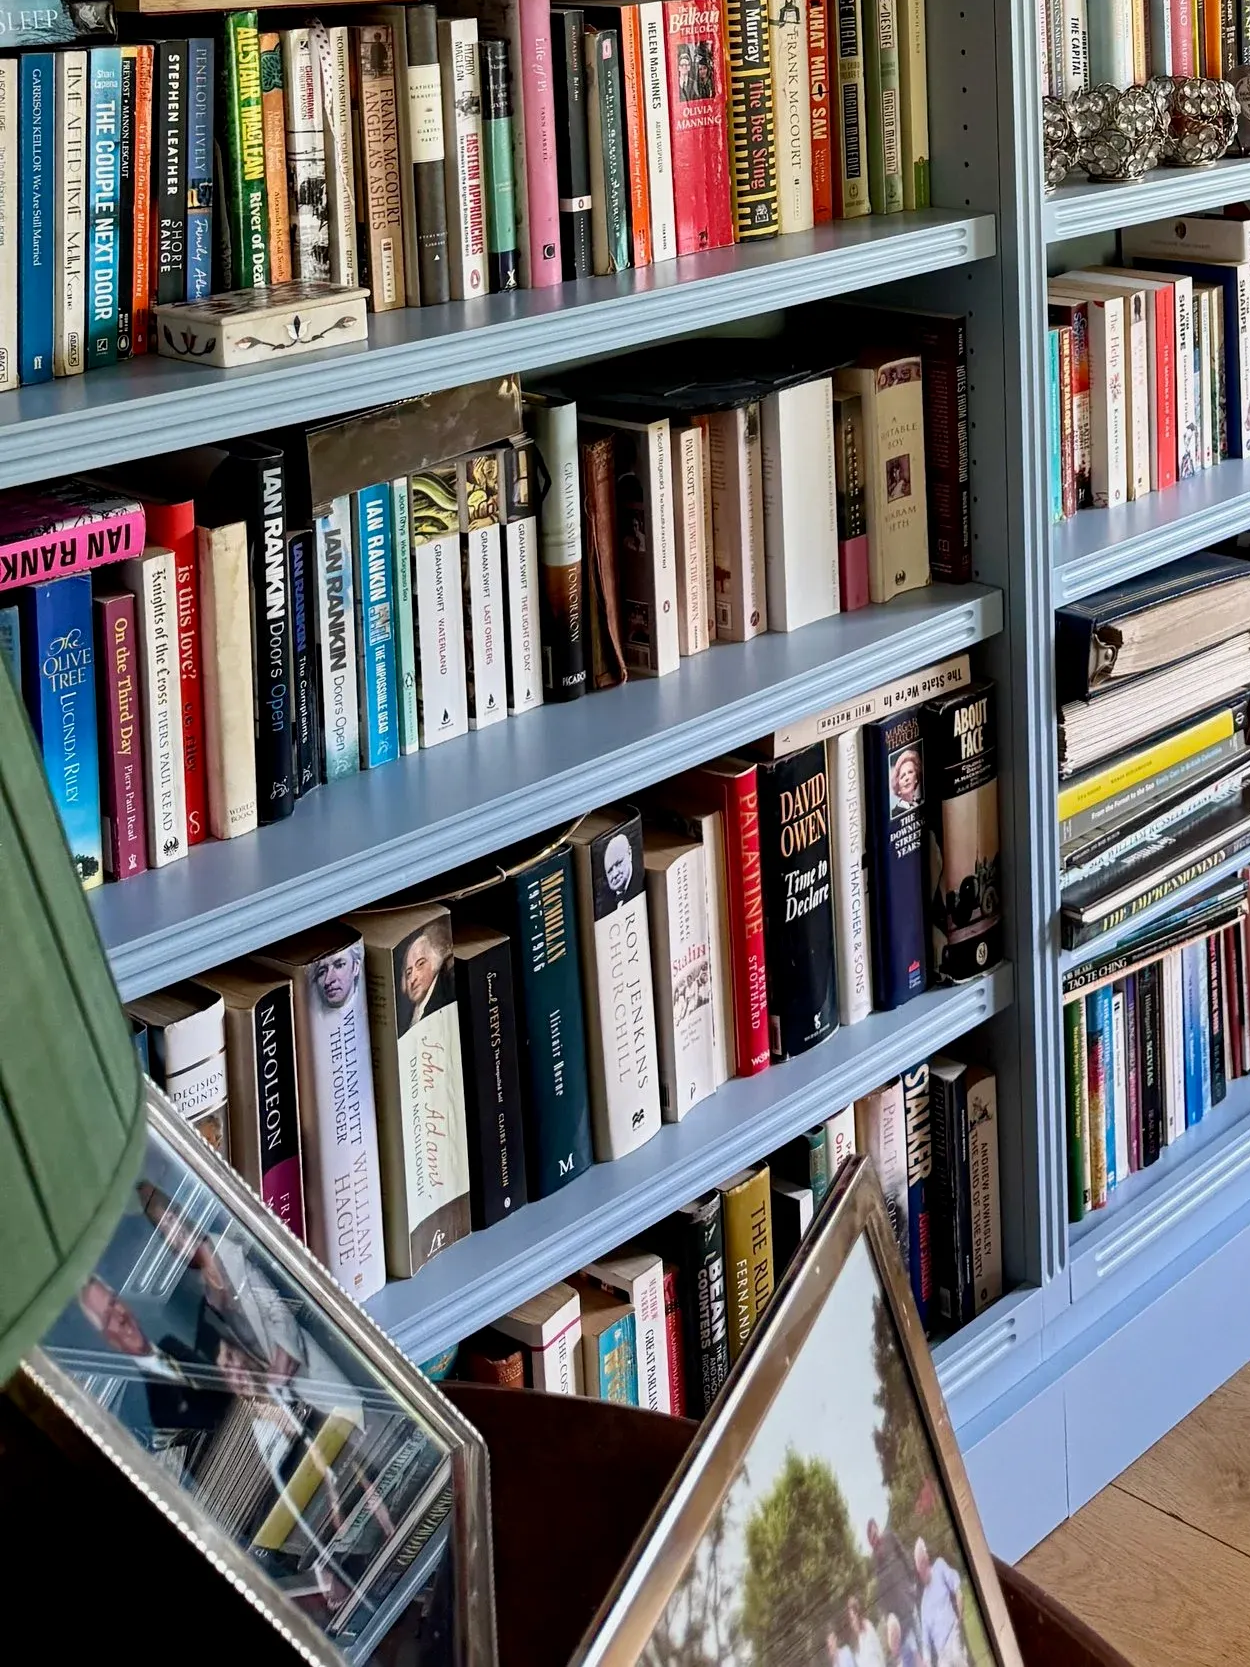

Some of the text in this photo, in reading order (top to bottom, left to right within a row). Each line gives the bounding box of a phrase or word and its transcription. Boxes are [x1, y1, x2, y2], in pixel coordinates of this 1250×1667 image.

[534, 38, 547, 92] Life of Pi
[647, 22, 661, 109] HELEN MacINNES
[745, 9, 762, 63] Murray
[1072, 37, 1080, 76] CAPITAL
[167, 54, 180, 194] STEPHEN LEATHER
[236, 27, 264, 180] ALISTAIR MACLEAN
[749, 80, 764, 110] The
[751, 114, 765, 141] Bee
[32, 69, 43, 266] GARRISON KEILLOR We Are Still Married
[94, 101, 115, 320] THE COUPLE NEXT DOOR
[365, 91, 385, 230] ANGELA'S ASHES
[381, 89, 400, 226] FRANK McCOURT
[466, 133, 484, 256] EASTERN APPROACHES
[750, 145, 768, 189] Sting
[161, 219, 172, 272] RANGE
[172, 221, 182, 270] SHORT
[1109, 312, 1121, 367] The Help
[1179, 294, 1187, 350] SHARPE
[88, 523, 131, 560] IAN
[263, 469, 287, 732] IAN RANKIN Doors Open
[434, 544, 448, 674] GRAHAM SWIFT WATERLAND
[116, 618, 134, 755] On the Third Day
[60, 693, 80, 803] LUCINDA RILEY
[779, 773, 825, 823] DAVID
[740, 790, 762, 939] PALATINE
[781, 804, 827, 857] OWEN
[542, 869, 566, 963] MACMILLAN
[608, 923, 631, 1083] CHURCHILL
[625, 913, 648, 1089] ROY JENKINS
[749, 955, 760, 1029] STOTHARD
[260, 1005, 281, 1151] NAPOLEON
[330, 1027, 347, 1145] THE YOUNGER
[343, 1010, 363, 1145] WILLIAM PITT
[410, 1057, 424, 1197] DAVID MCCULLOUGH
[421, 1035, 446, 1188] John Adams
[905, 1063, 931, 1187] STALKER
[334, 1176, 356, 1265] HAGUE
[353, 1151, 372, 1266] WILLIAM
[698, 1269, 711, 1348] COUNTERS
